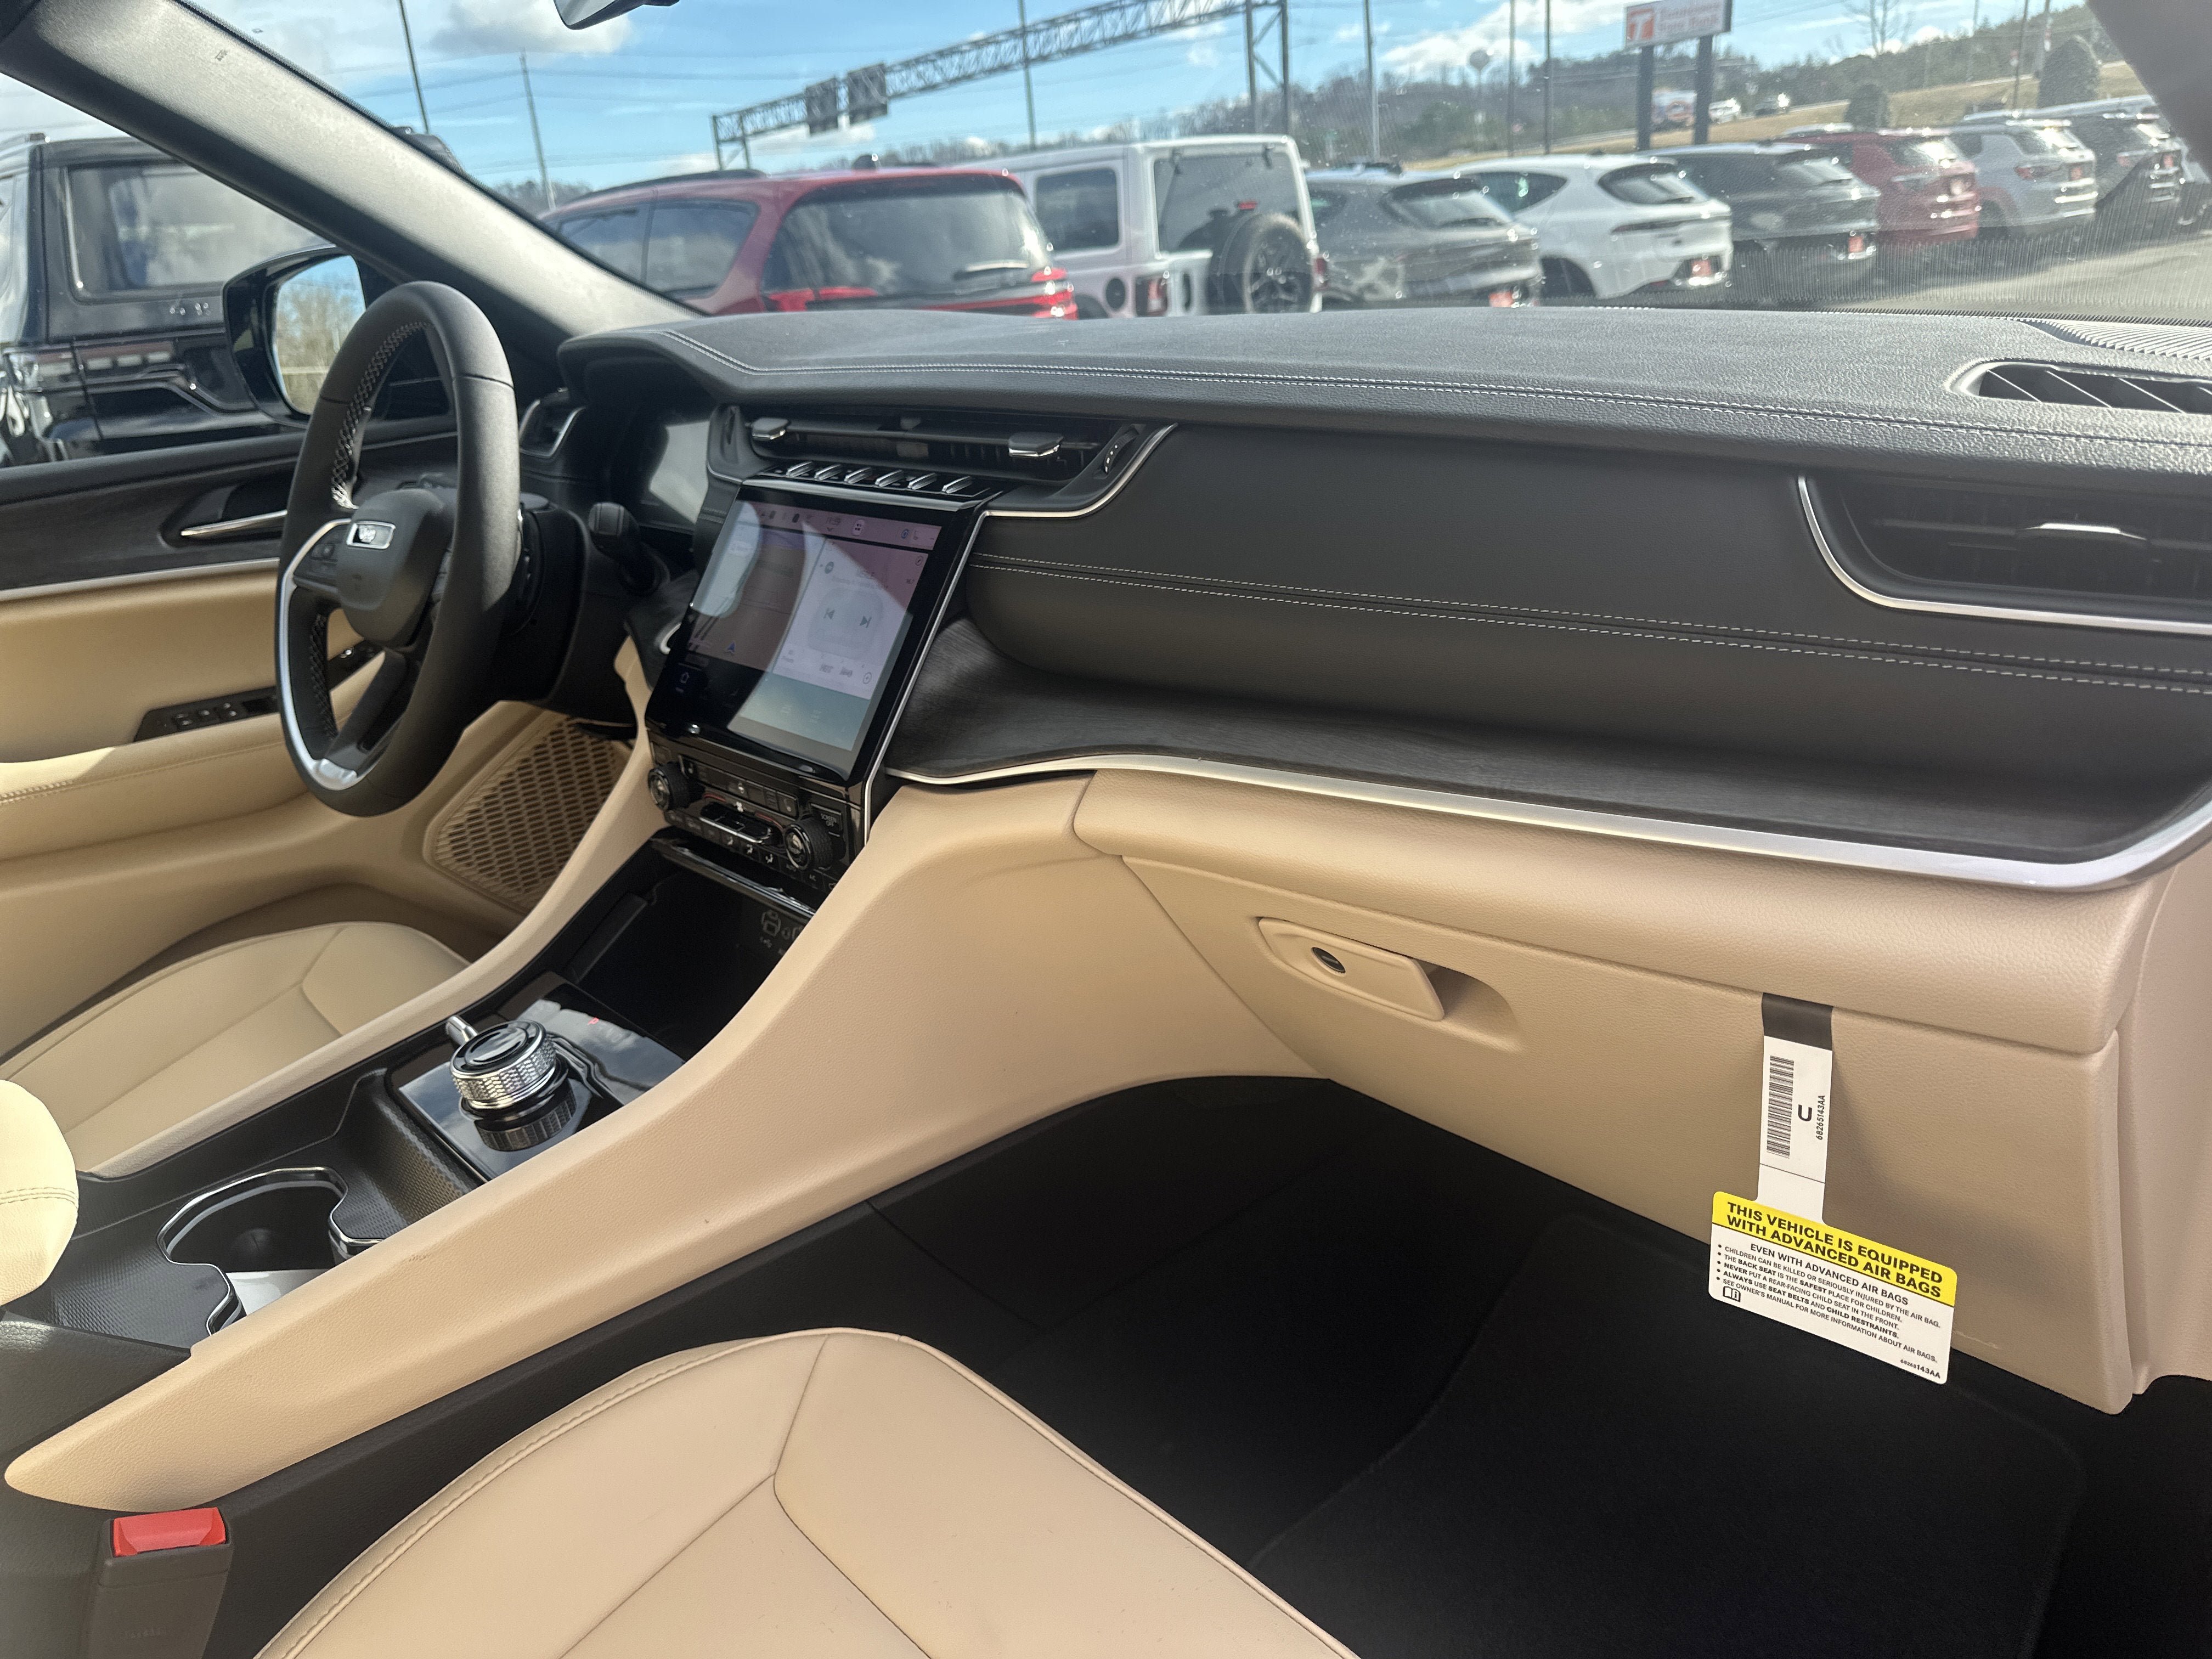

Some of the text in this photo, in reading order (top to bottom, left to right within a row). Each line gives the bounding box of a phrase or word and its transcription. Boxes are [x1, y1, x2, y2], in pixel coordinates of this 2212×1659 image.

[1816, 1095, 1825, 1141] 68265143AA
[1727, 1215, 1941, 1297] WITH ADVANCED AIR BAGS
[1728, 1201, 1943, 1283] THIS VEHICLE IS EQUIPPED
[1751, 1243, 1909, 1305] EVEN WITH ADVANCED AIR BAGS
[1723, 1271, 1899, 1339] ALWAYS USE SEAT BELTS AND CHILD RESTRAINTS.
[1723, 1278, 1938, 1363] SEE OWNER'S MANUAL FOR MORE INFORMATION ABOUT AIR BAGS.
[1724, 1254, 1737, 1262] THE
[1738, 1259, 1758, 1270] BACK
[1758, 1266, 1777, 1276] SEAT
[1786, 1274, 1798, 1284] THE
[1799, 1279, 1827, 1294] SAFEST
[1828, 1290, 1849, 1302] PLACE
[1850, 1298, 1865, 1308] FOR
[1865, 1304, 1902, 1323] CHILDREN.
[1724, 1262, 1748, 1274] NEVER
[1749, 1271, 1762, 1279] PUT
[1769, 1278, 1811, 1296] REAR-FACING
[1812, 1293, 1832, 1304] CHILD
[1833, 1300, 1850, 1311] SEAT
[1860, 1310, 1874, 1320] THE
[1875, 1316, 1899, 1330] FRONT.
[1725, 1246, 1757, 1261] CHILDREN
[1758, 1257, 1771, 1266] CAN
[1783, 1265, 1805, 1278] KILLED
[1818, 1278, 1854, 1295] SERIOUSLY
[1855, 1291, 1884, 1306] INJURED
[1896, 1306, 1910, 1316] THE
[1910, 1312, 1923, 1322] AIR
[1924, 1317, 1940, 1328] BAG.
